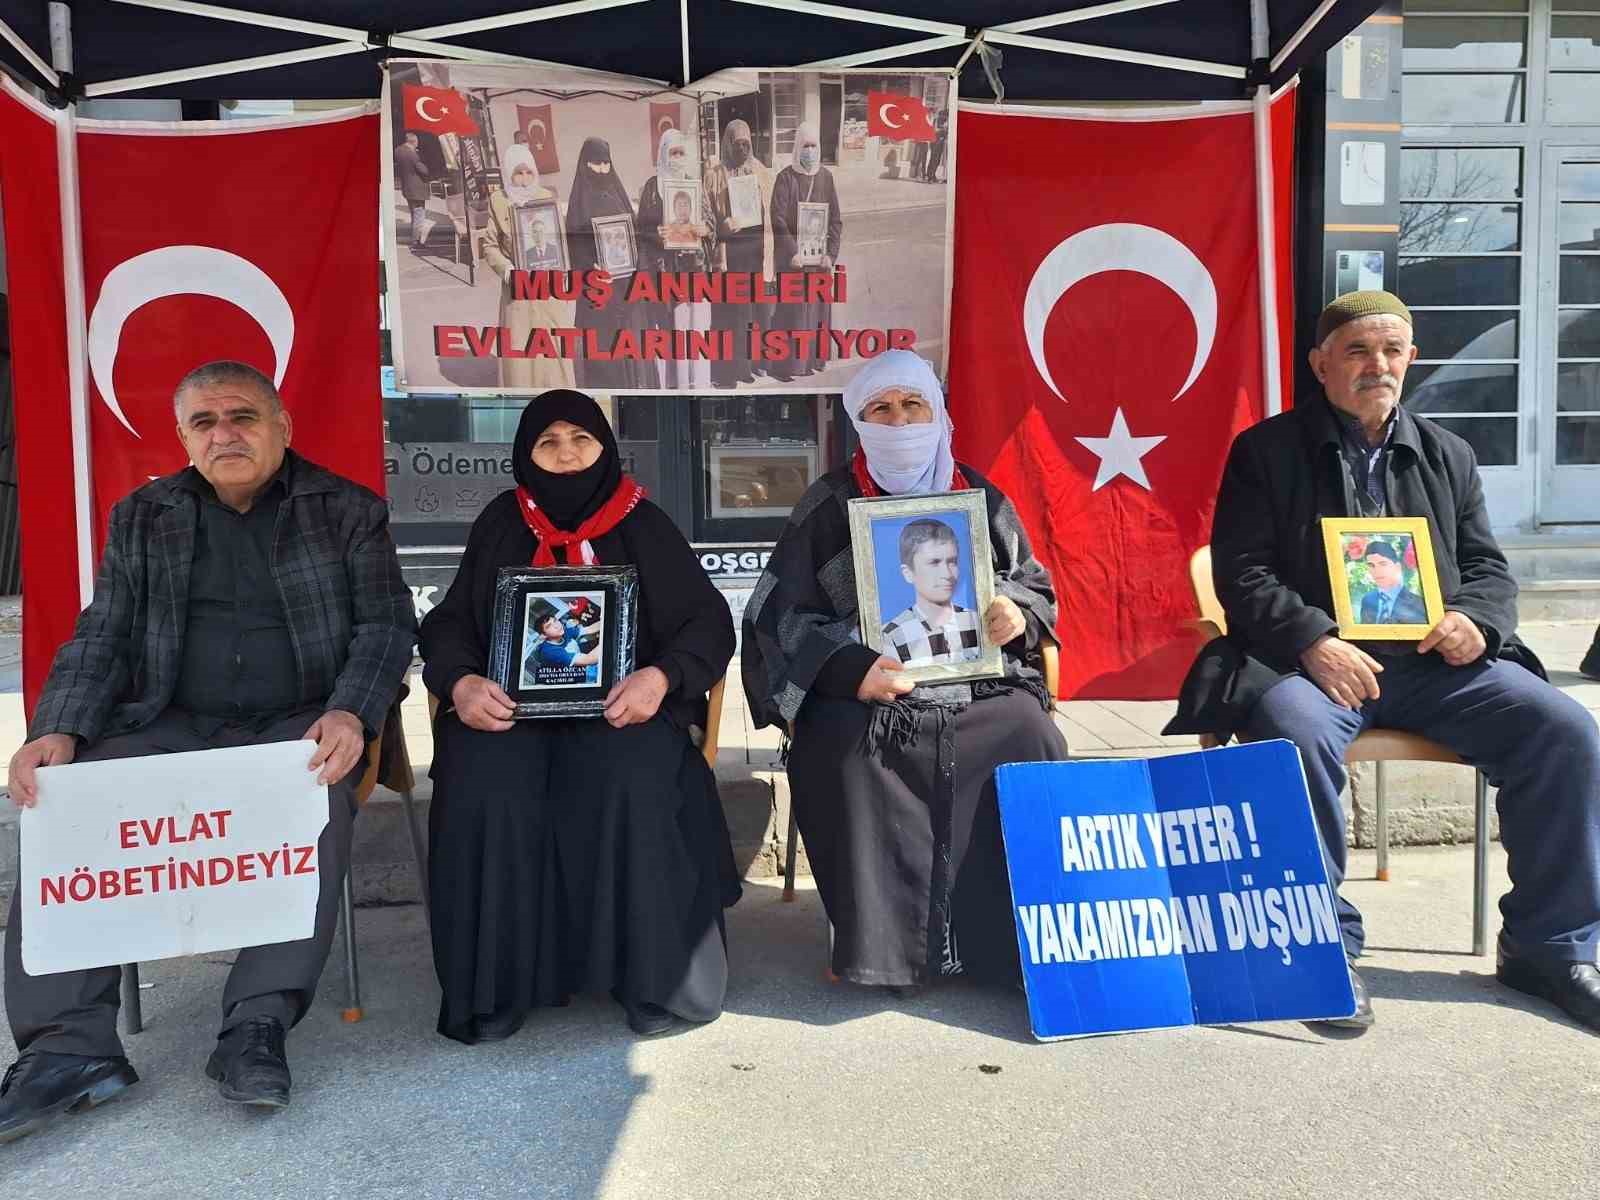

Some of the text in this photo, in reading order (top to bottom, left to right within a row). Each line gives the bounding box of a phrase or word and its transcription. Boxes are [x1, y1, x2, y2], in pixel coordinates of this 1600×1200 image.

[511, 265, 848, 310] MUŞ ANNELERİ
[434, 320, 917, 362] EVLATLARINI İSTİYOR
[119, 810, 232, 848] EVLAT
[1060, 813, 1147, 872] ARTIK
[1144, 804, 1243, 868] YETER
[40, 842, 315, 906] NÖBETİNDEYİZ
[1018, 870, 1340, 966] YAKAMIZDAN DÜŞÜN
